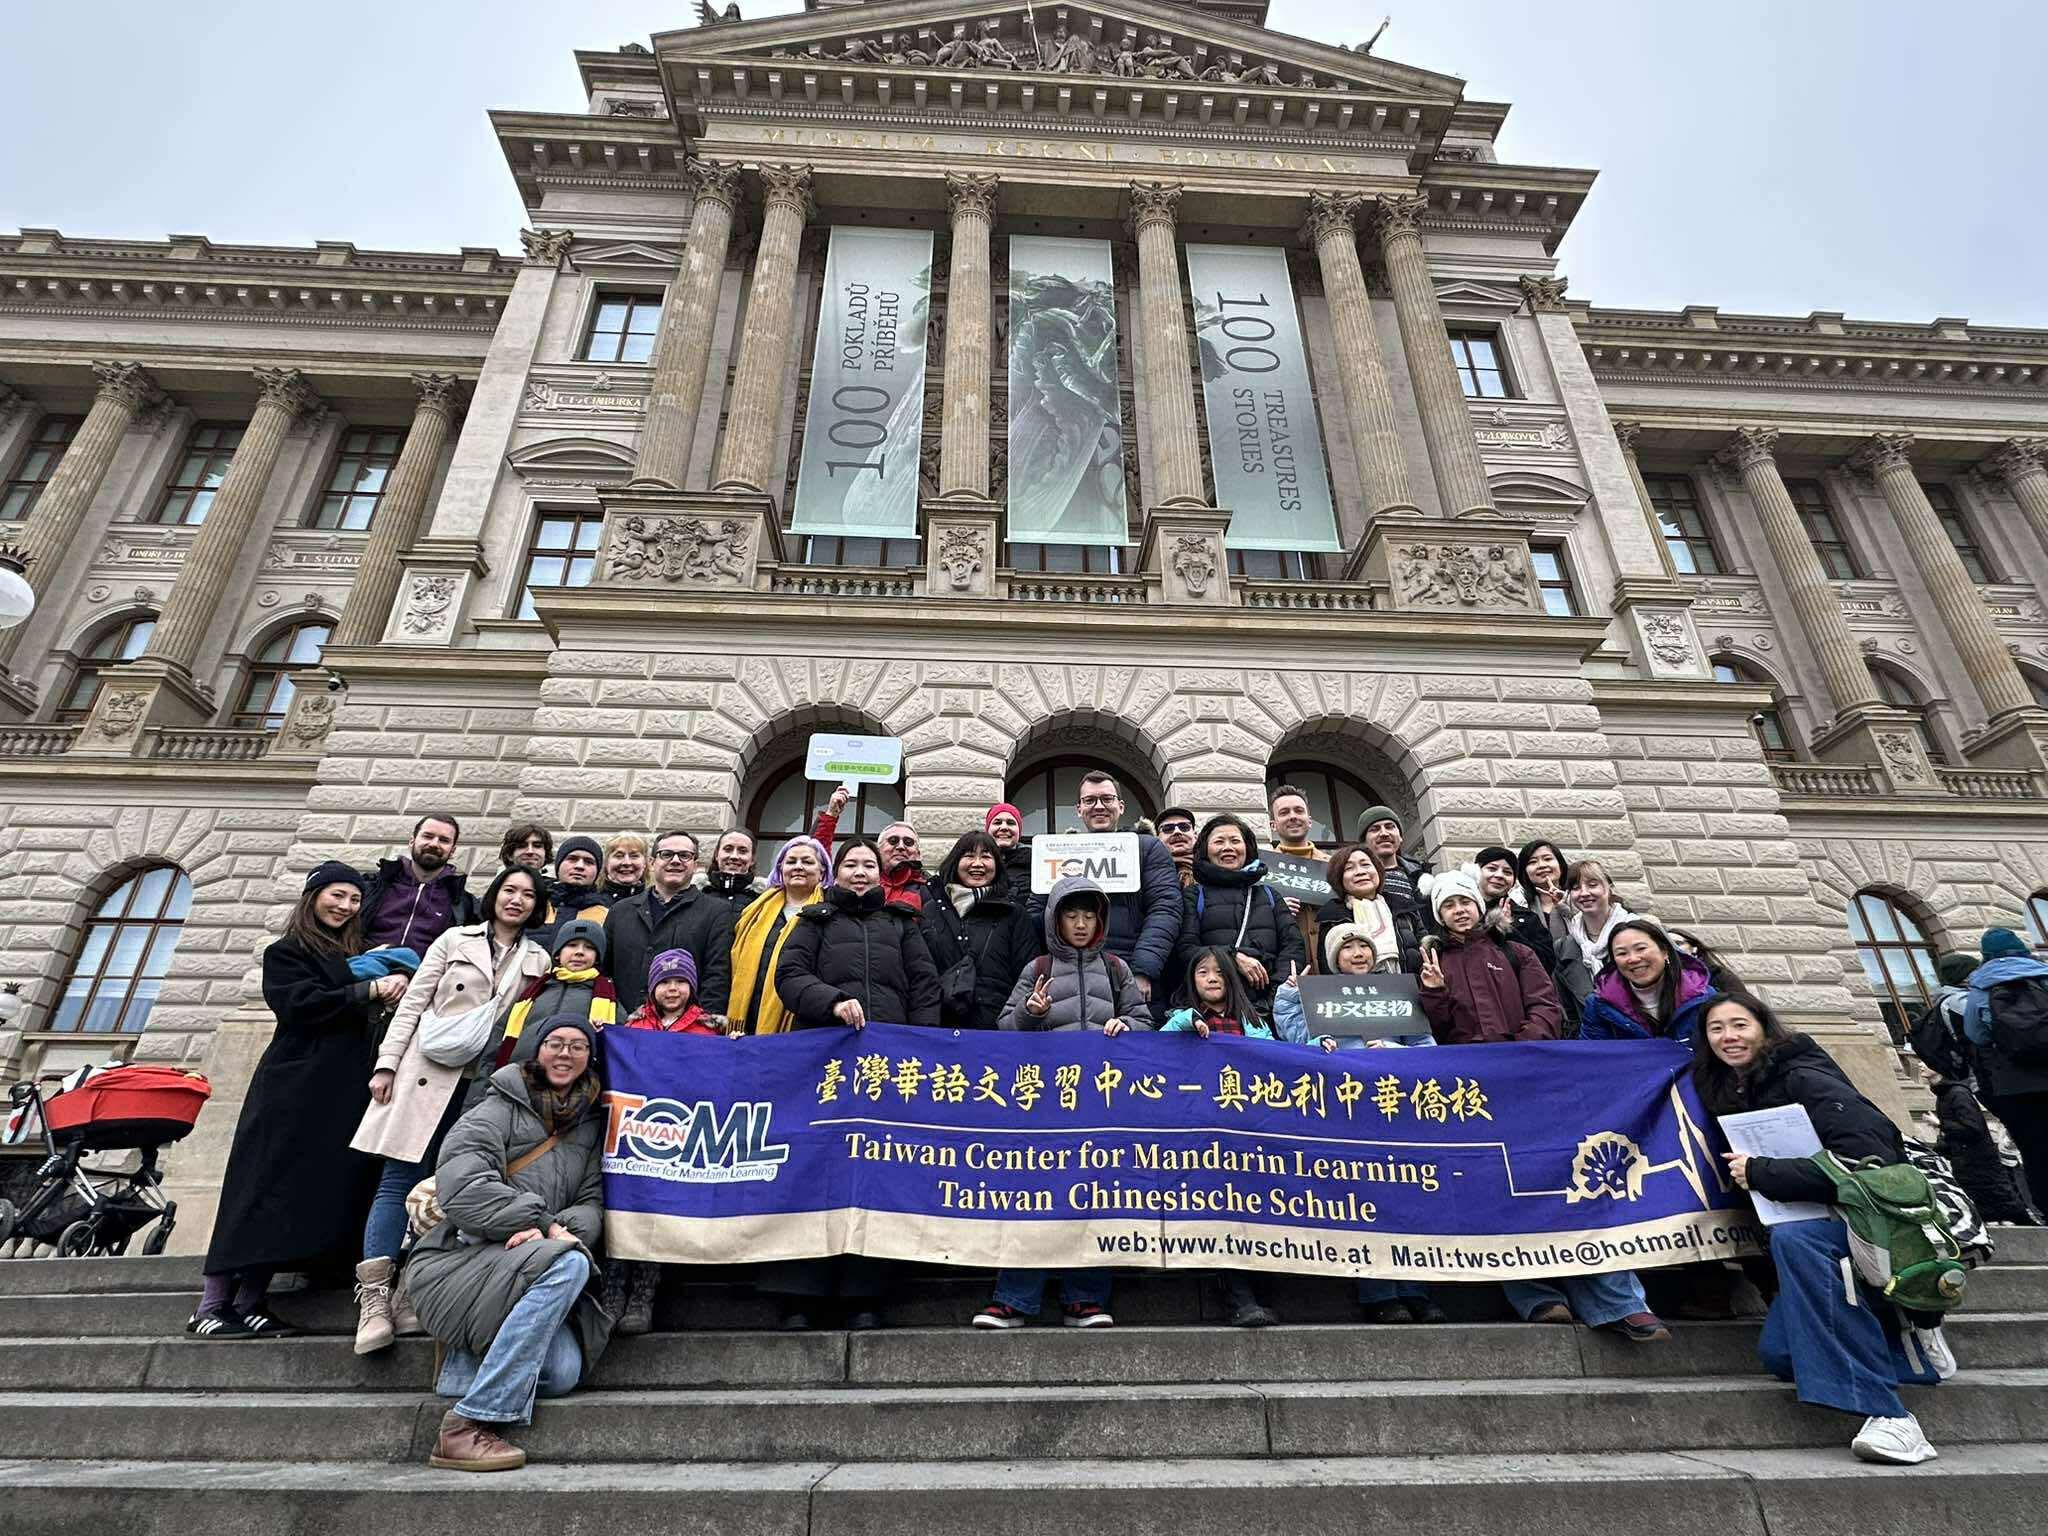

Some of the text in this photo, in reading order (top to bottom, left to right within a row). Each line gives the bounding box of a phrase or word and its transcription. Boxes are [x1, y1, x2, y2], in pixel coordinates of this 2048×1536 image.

[842, 281, 870, 372] POKLADŮ
[870, 290, 900, 373] PŘÍBĚHŮ
[1216, 290, 1281, 373] 100
[825, 385, 891, 480] 100
[1232, 387, 1265, 475] STORIES
[1263, 389, 1302, 512] TREASURES
[1043, 857, 1128, 880] TCML
[1316, 999, 1413, 1018] 中文怪物
[816, 1053, 1167, 1111] 臺灣華語文學習中心
[1213, 1064, 1493, 1123] 奧地利中華僑校
[602, 1091, 787, 1164] TCML
[845, 1133, 957, 1168] Taiwan
[965, 1142, 1072, 1170] Center
[1078, 1140, 1126, 1169] for
[1132, 1141, 1287, 1175] Mandarin
[1293, 1150, 1440, 1192] Learning
[625, 1160, 660, 1173] Center
[662, 1166, 677, 1177] for
[938, 1180, 1377, 1223] Taiwan Chinesische Schule
[1097, 1231, 1372, 1265] web:www.twschule.at
